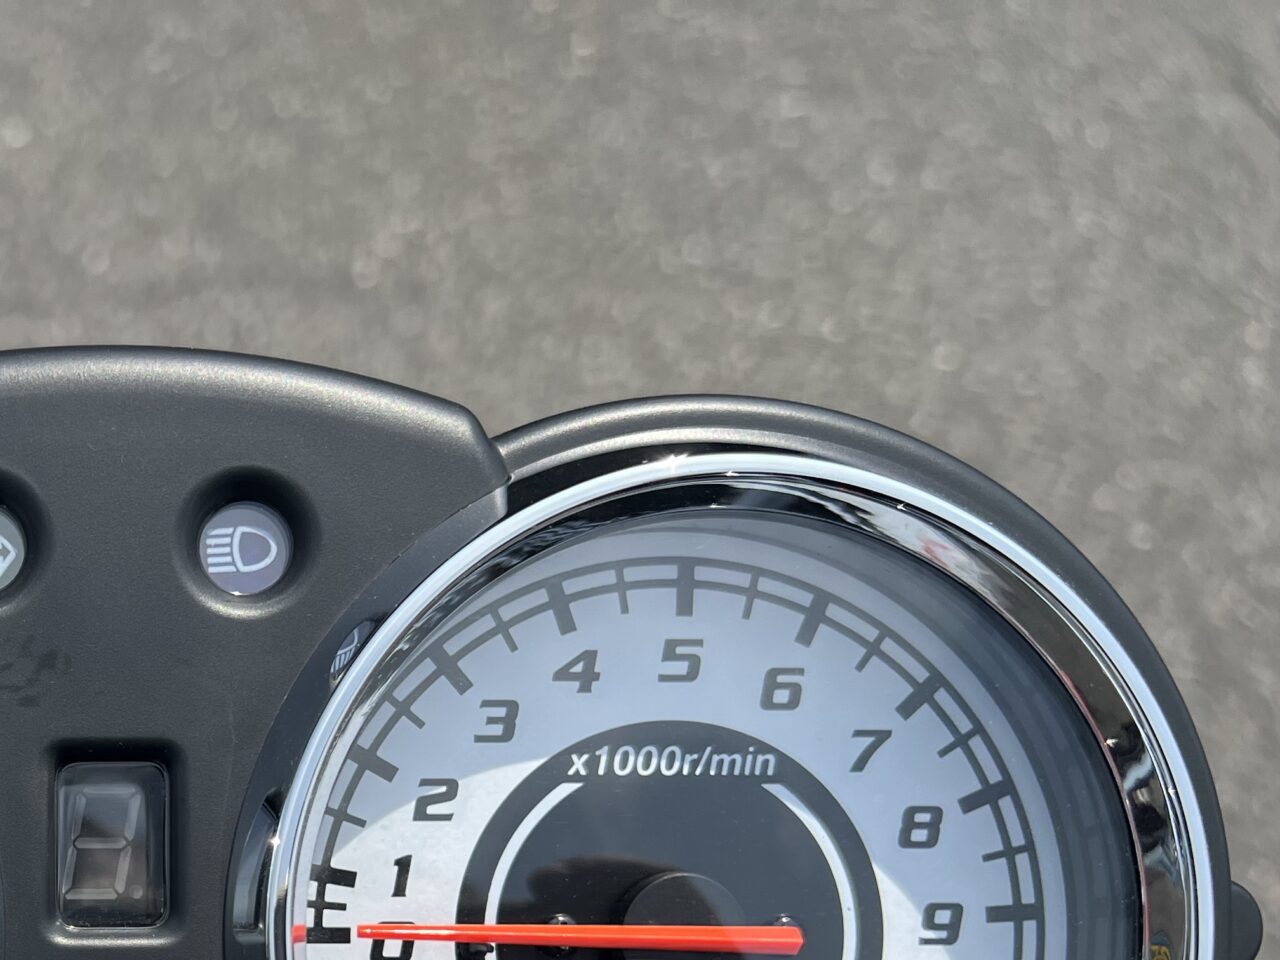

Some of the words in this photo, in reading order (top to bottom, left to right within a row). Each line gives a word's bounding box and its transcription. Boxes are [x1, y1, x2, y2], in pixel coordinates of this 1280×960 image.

[552, 650, 601, 694] 4
[658, 639, 704, 683] 5
[760, 667, 805, 711] 6
[473, 699, 520, 743] 3
[567, 745, 776, 777] x1000r/min
[849, 729, 893, 773] 7
[412, 778, 460, 822] 2
[897, 805, 944, 849] 8
[391, 855, 413, 898] 1
[918, 902, 964, 946] 9
